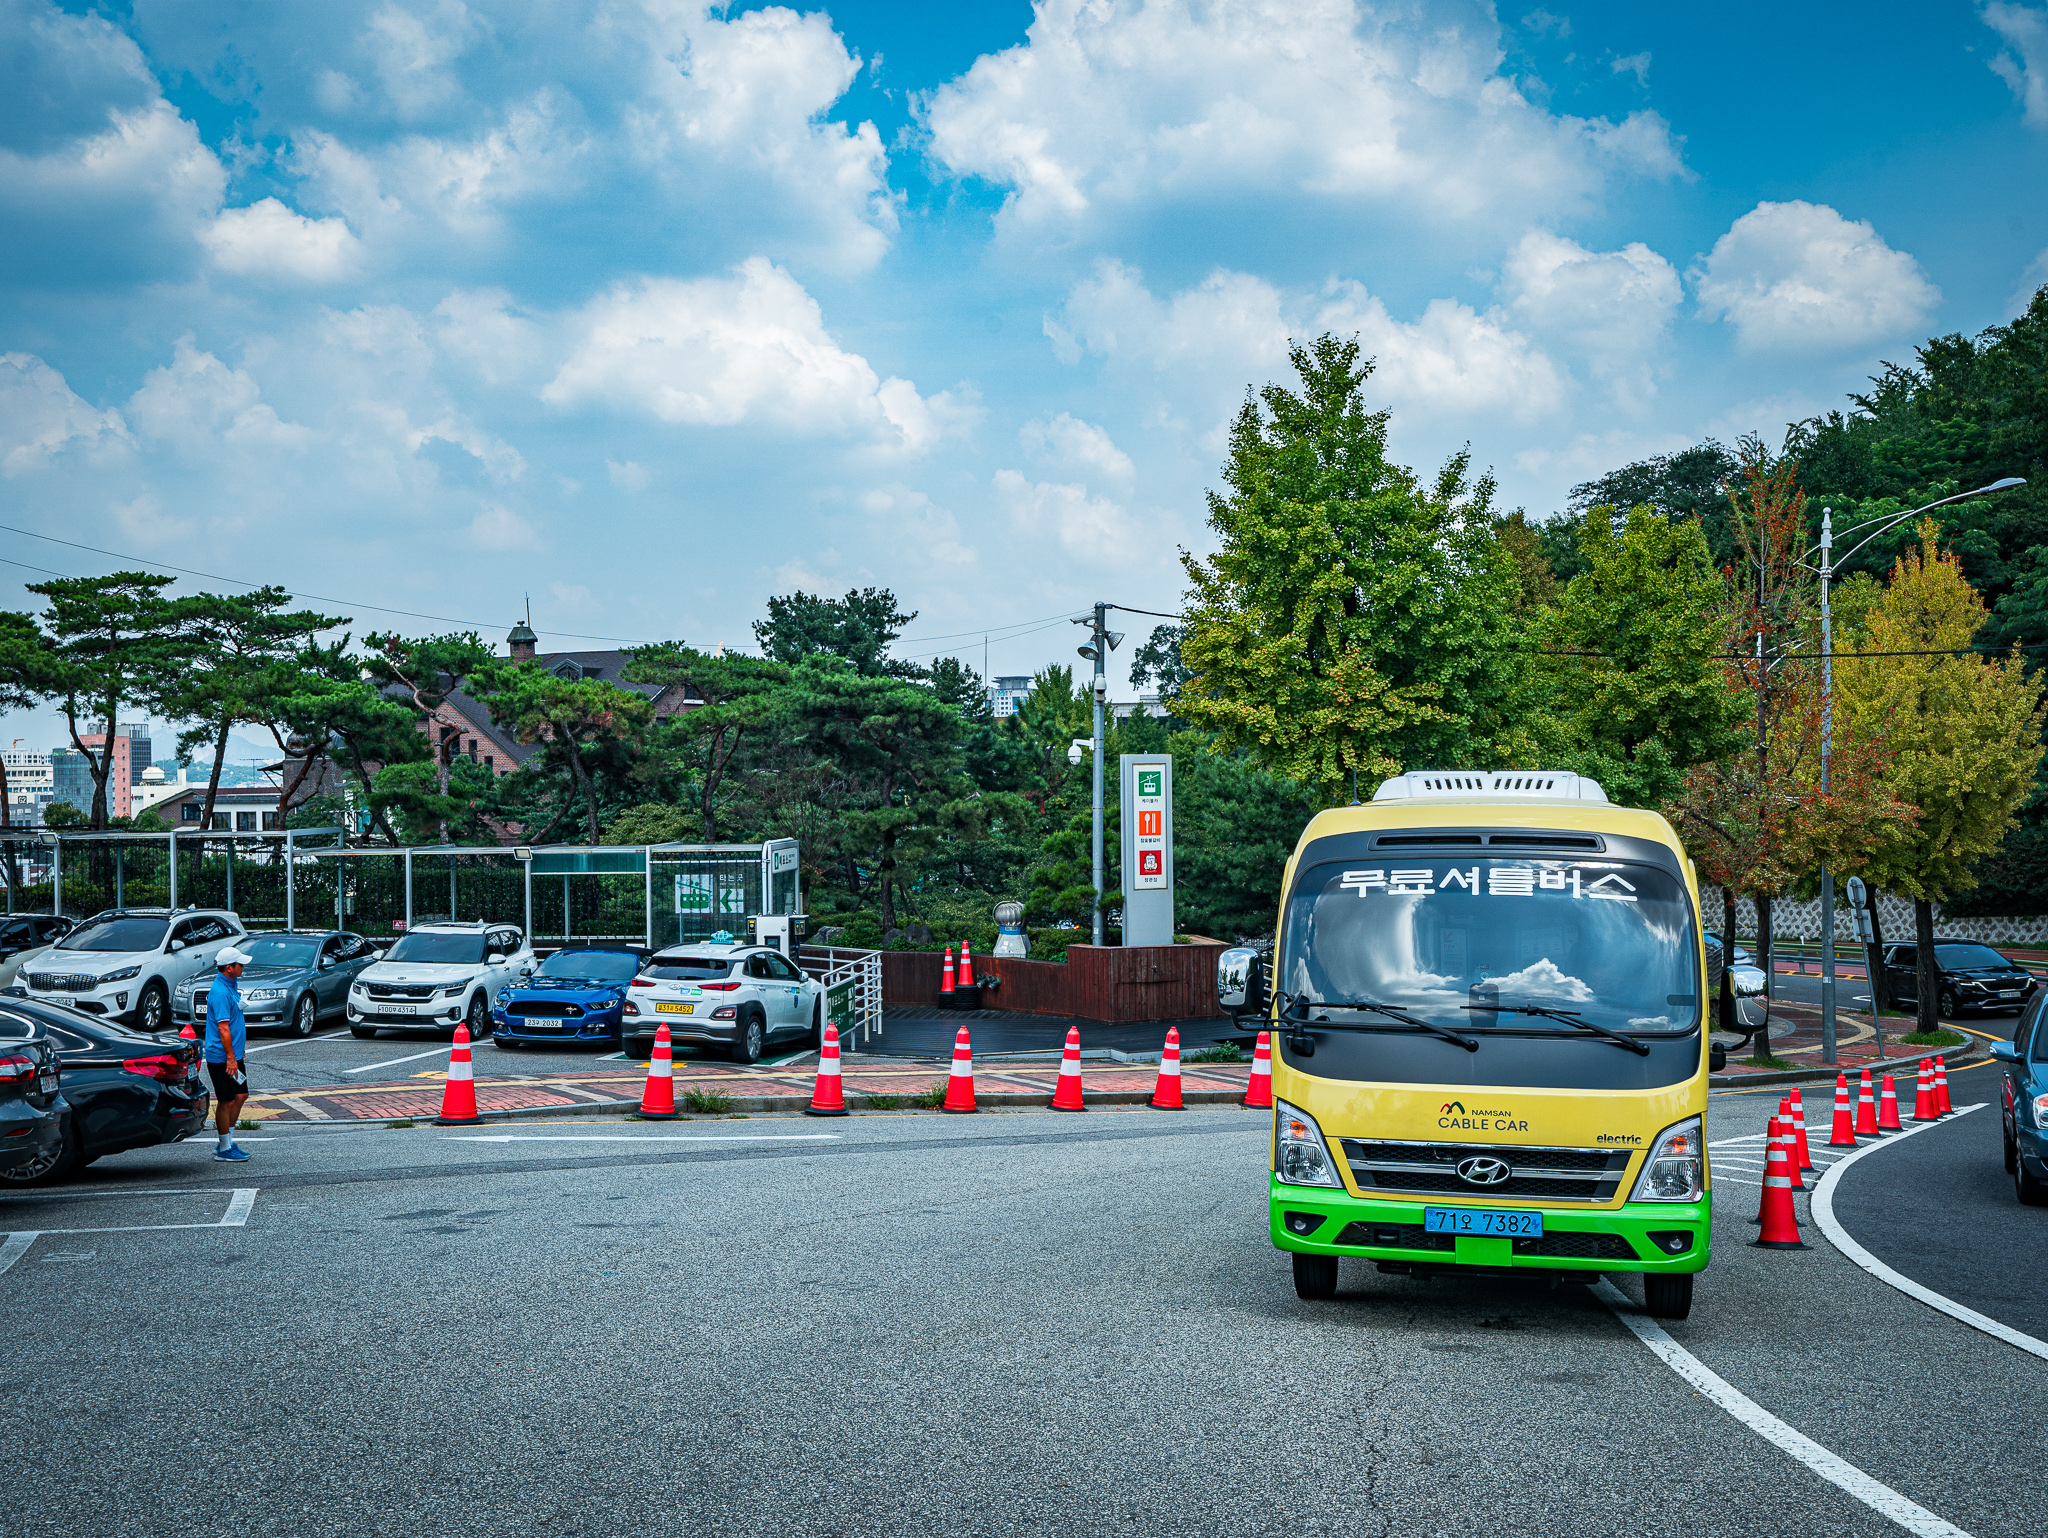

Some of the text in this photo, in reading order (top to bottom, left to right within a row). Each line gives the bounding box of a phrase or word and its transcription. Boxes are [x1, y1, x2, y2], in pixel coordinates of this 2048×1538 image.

[1339, 866, 1638, 902] 무료셔틀버스
[675, 1005, 691, 1013] 5452
[1471, 1109, 1512, 1117] NAMSAN
[1438, 1117, 1529, 1132] CABLE CAR
[1596, 1133, 1642, 1145] electric
[1436, 1211, 1531, 1234] 71오 7382
